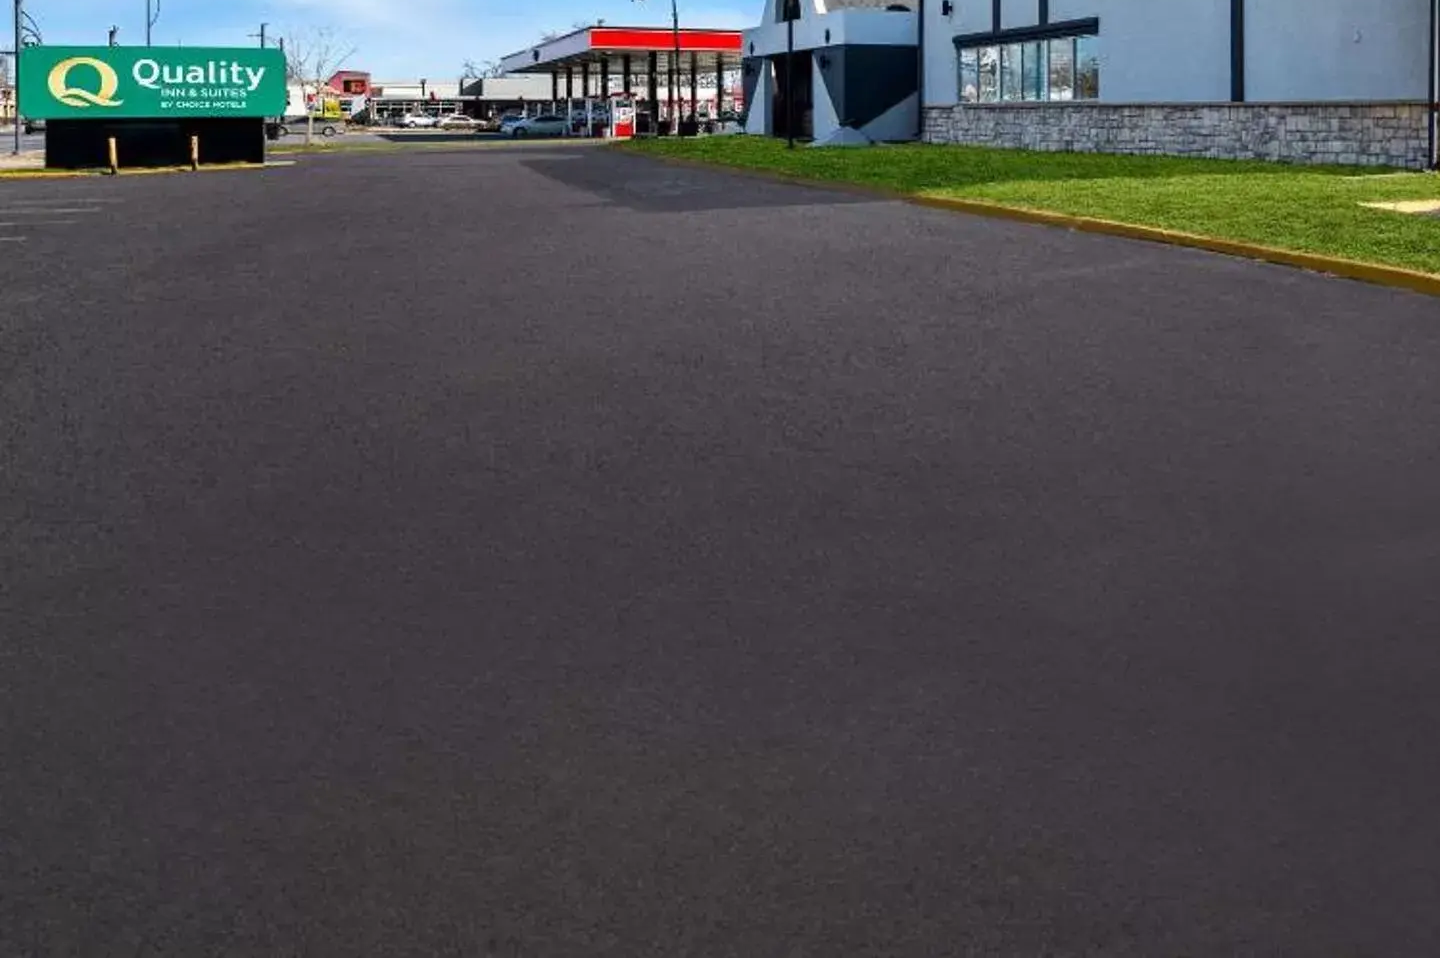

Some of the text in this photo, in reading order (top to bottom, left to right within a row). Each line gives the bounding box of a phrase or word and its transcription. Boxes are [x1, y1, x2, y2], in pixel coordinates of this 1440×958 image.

[47, 56, 124, 107] Q
[132, 58, 266, 91] Quality
[161, 88, 186, 97] INN
[200, 88, 247, 98] SUITES
[212, 101, 247, 109] HOTELS
